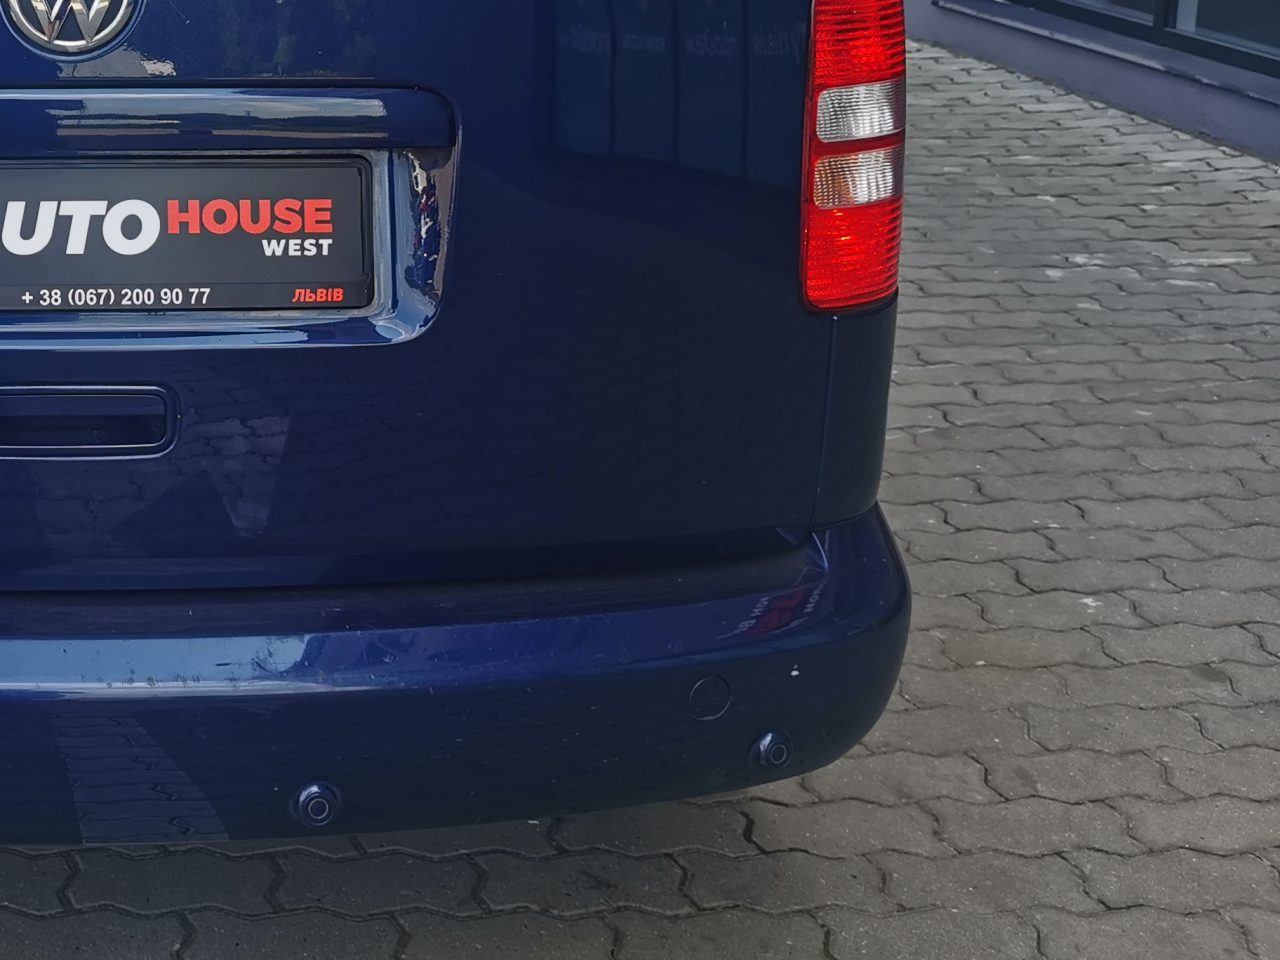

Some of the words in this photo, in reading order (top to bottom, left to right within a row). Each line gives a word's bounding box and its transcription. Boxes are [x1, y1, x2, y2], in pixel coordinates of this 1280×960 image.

[261, 238, 333, 257] WEST
[67, 288, 115, 306] (067)
[120, 288, 155, 305] 200
[160, 288, 183, 305] 90
[188, 287, 211, 305] 77
[292, 287, 344, 303] ЛЬВІВ
